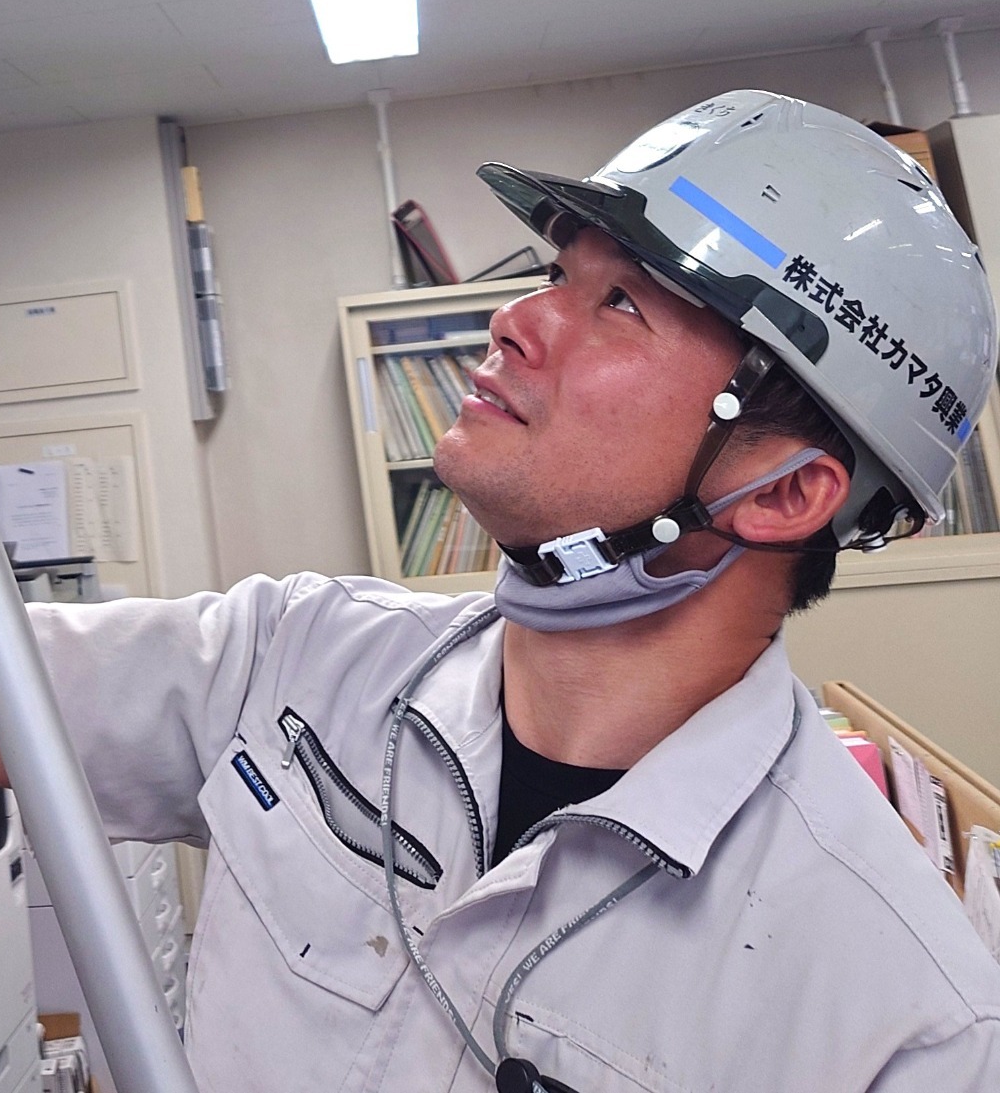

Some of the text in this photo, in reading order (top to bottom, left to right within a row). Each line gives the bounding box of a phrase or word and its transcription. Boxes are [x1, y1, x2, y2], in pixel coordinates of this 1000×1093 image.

[782, 254, 967, 435] 株式会社カマタ興業
[385, 741, 395, 767] ARE
[380, 767, 392, 826] FRIENDS!
[522, 951, 541, 971] WE
[539, 932, 562, 956] ARE
